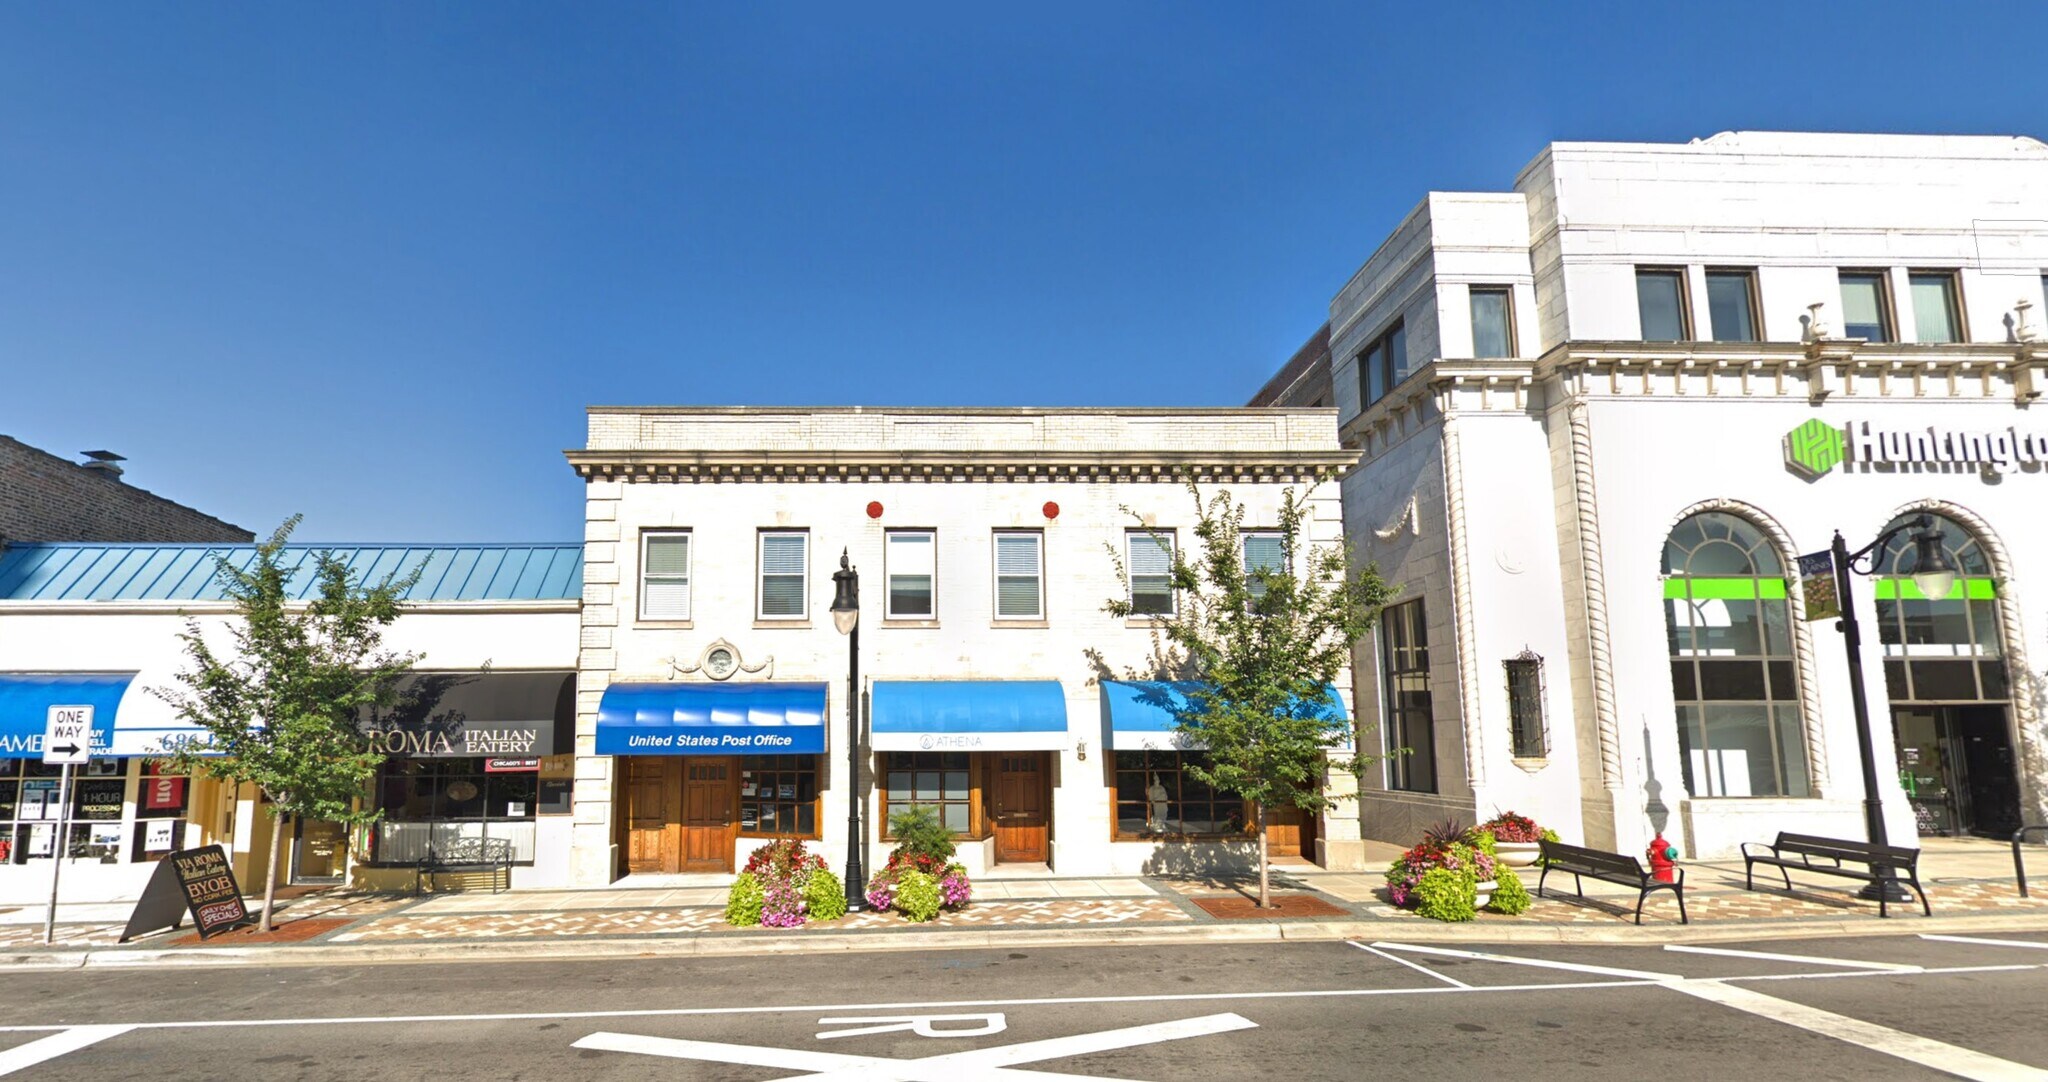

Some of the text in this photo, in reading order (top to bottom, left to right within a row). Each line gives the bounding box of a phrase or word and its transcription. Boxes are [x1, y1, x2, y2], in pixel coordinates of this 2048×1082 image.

[56, 710, 84, 723] ONE
[54, 726, 83, 738] WAY
[90, 729, 104, 737] UY
[464, 729, 537, 741] ITALIAN
[367, 730, 454, 753] ROMA
[628, 734, 792, 746] United States Post Office
[936, 736, 982, 747] ATHENA
[465, 741, 535, 753] EATERY
[90, 792, 121, 803] HOUR
[82, 804, 121, 812] PROCESSING
[176, 852, 223, 869] VIA ROMA
[201, 905, 219, 916] DAILY
[204, 907, 240, 925] SPECIALS
